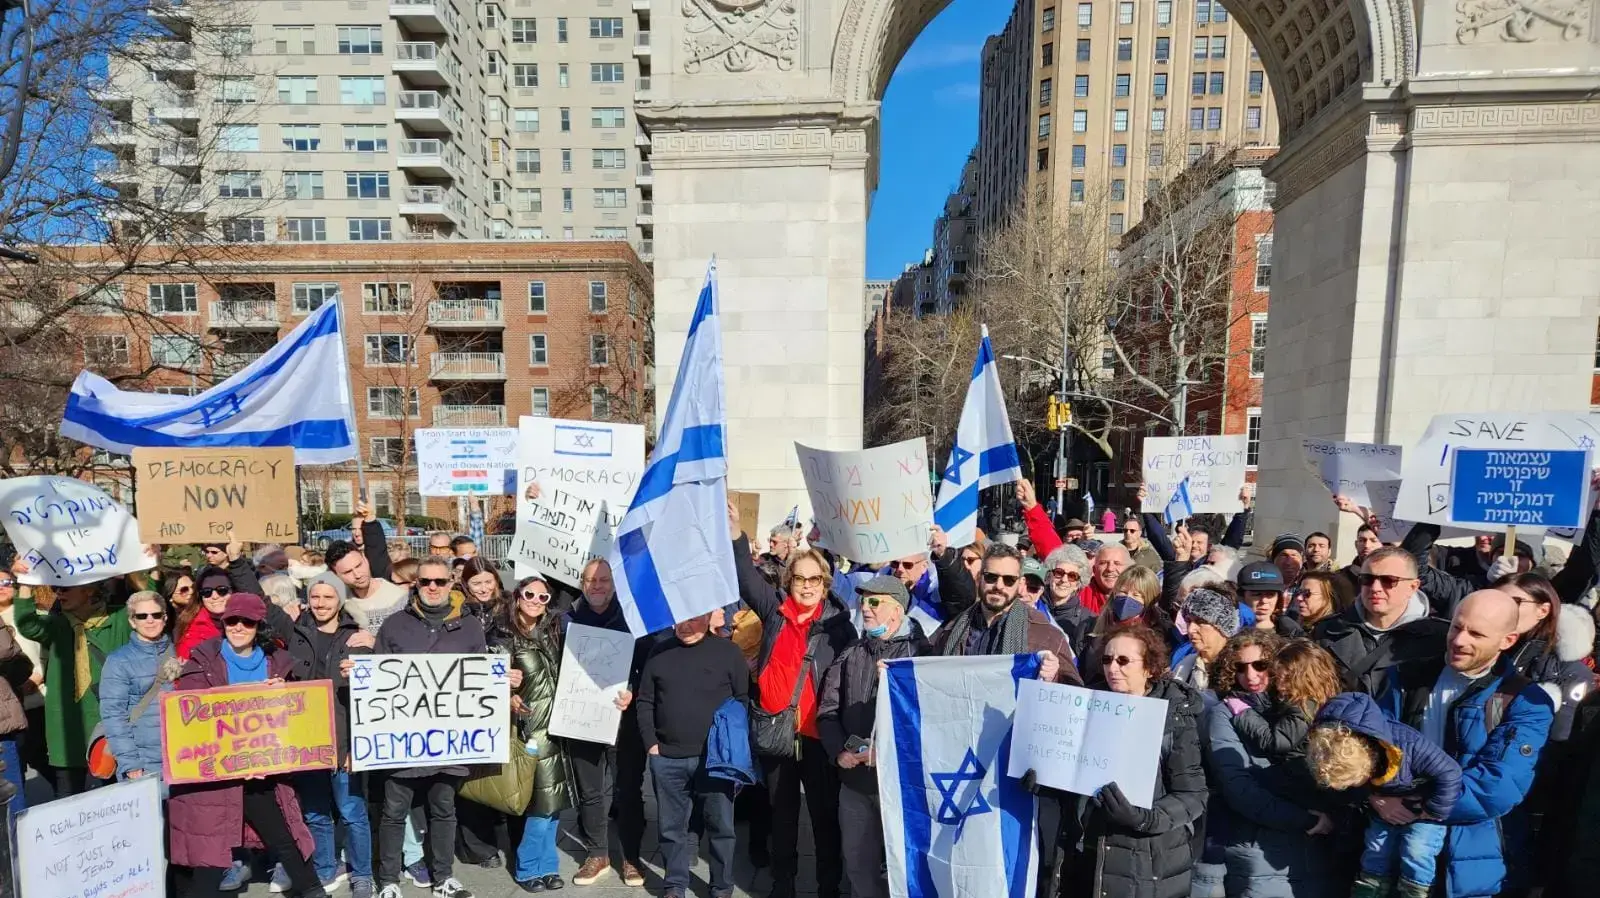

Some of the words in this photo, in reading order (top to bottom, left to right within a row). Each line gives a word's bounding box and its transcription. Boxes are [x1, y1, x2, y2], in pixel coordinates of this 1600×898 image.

[469, 430, 481, 438] Up
[484, 430, 512, 438] Nation
[1449, 419, 1528, 441] SAVE
[1177, 437, 1212, 451] BIDEN
[487, 461, 514, 469] Nation
[897, 449, 924, 477] לא
[1191, 450, 1243, 467] FASCISM
[1486, 451, 1551, 467] עצמאות
[148, 459, 282, 481] DEMOCRACY
[524, 466, 637, 495] DMOCRACY
[1484, 466, 1550, 480] שיפוטית
[1147, 482, 1161, 493] NO
[1508, 479, 1522, 492] זו
[183, 484, 248, 513] NOW
[902, 485, 932, 519] לא
[1145, 496, 1160, 508] NO
[1192, 493, 1211, 503] AID
[1477, 491, 1554, 509] דמוקרטיה
[1483, 508, 1543, 524] אמיתית
[158, 521, 186, 538] AND
[265, 522, 294, 538] ALL
[376, 656, 489, 692] SAVE
[354, 692, 499, 725] ISRAEL'S
[1038, 688, 1136, 720] DEMOCRACY
[216, 712, 289, 739] NOW
[354, 727, 501, 760] DEMOCRACY
[35, 827, 44, 844] A
[50, 817, 77, 837] REAL
[45, 855, 71, 881] NOT
[76, 844, 105, 869] JUST
[81, 857, 115, 883] JEWS
